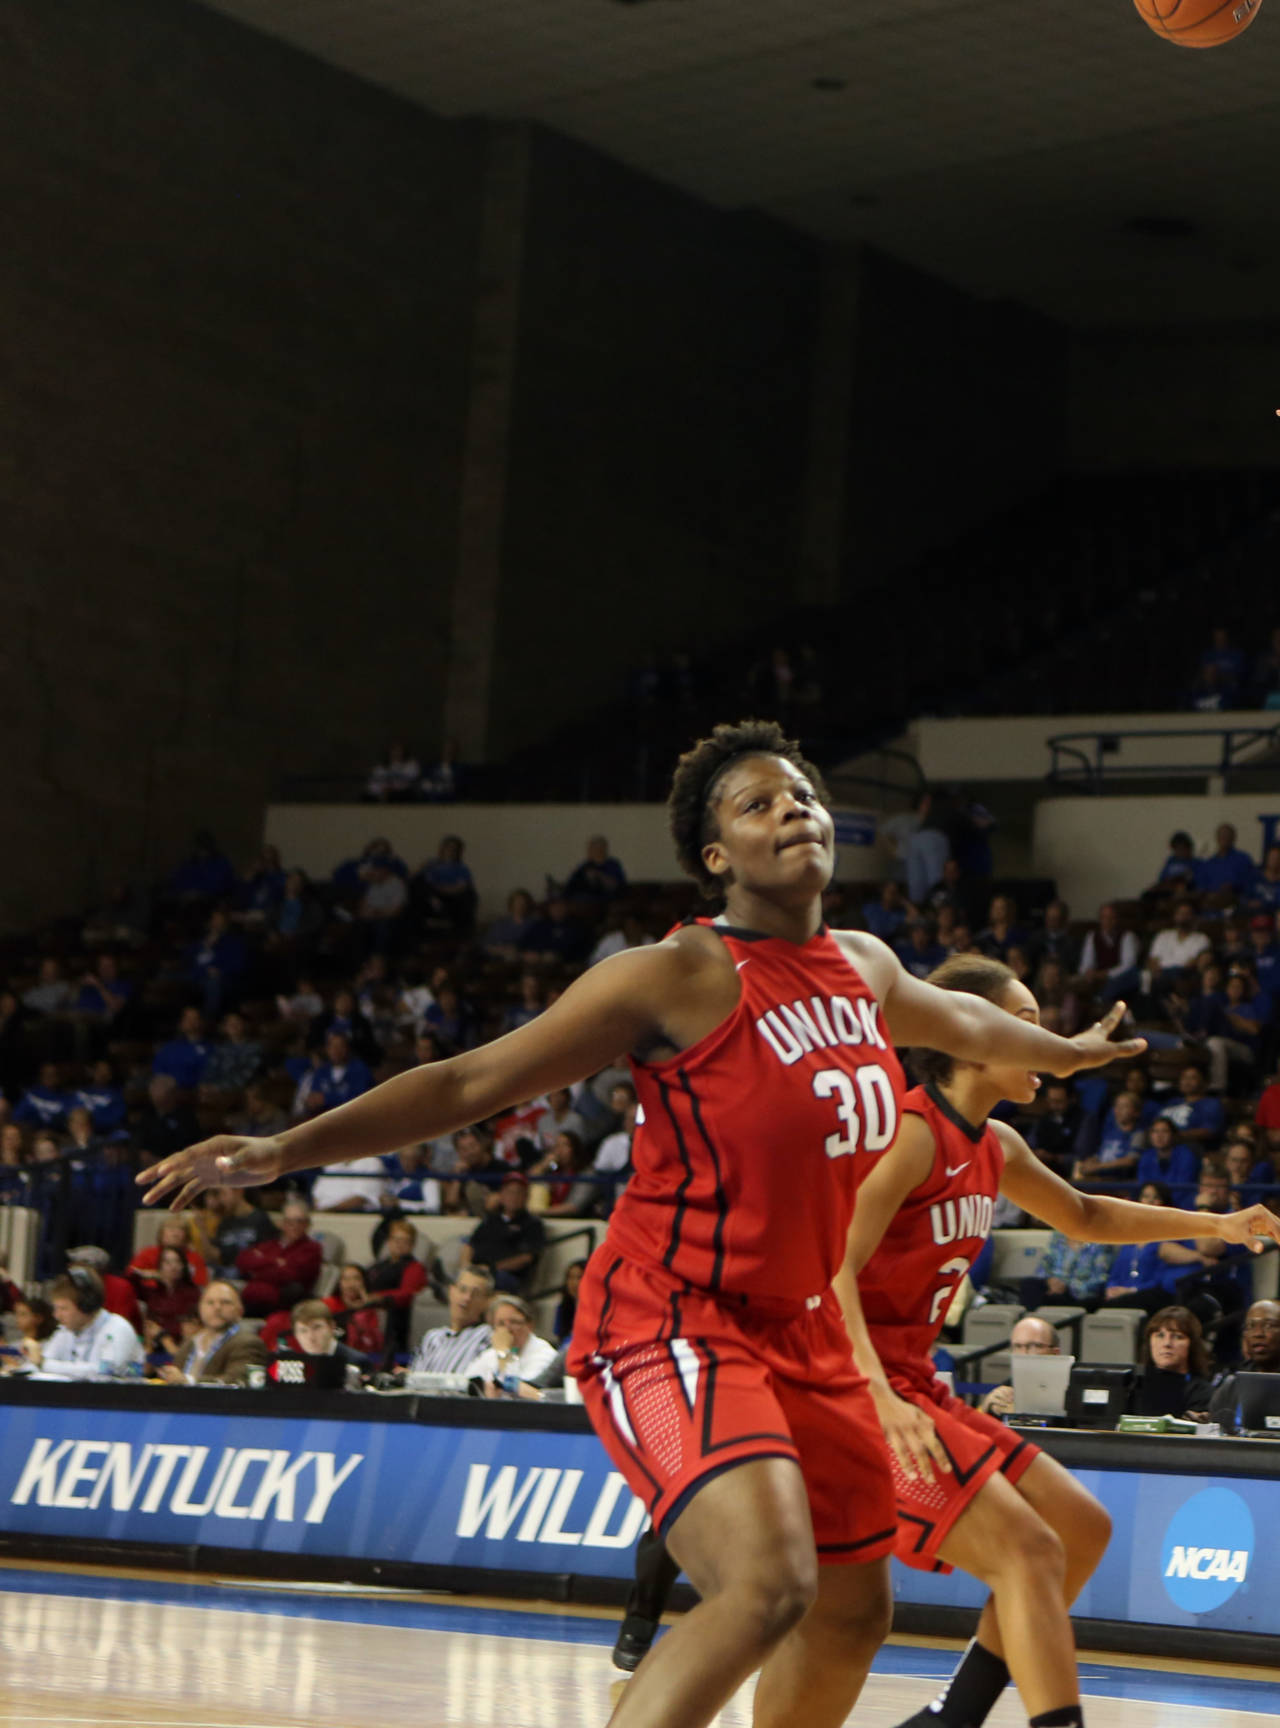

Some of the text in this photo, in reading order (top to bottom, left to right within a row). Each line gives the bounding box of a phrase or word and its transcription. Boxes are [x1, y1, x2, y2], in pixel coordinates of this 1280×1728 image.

[756, 995, 887, 1066] UNION
[812, 1064, 897, 1159] 30
[930, 1194, 997, 1245] UNIO
[11, 1437, 365, 1524] KENTUCKY
[456, 1463, 651, 1549] WILD
[1164, 1546, 1249, 1582] NCAA
